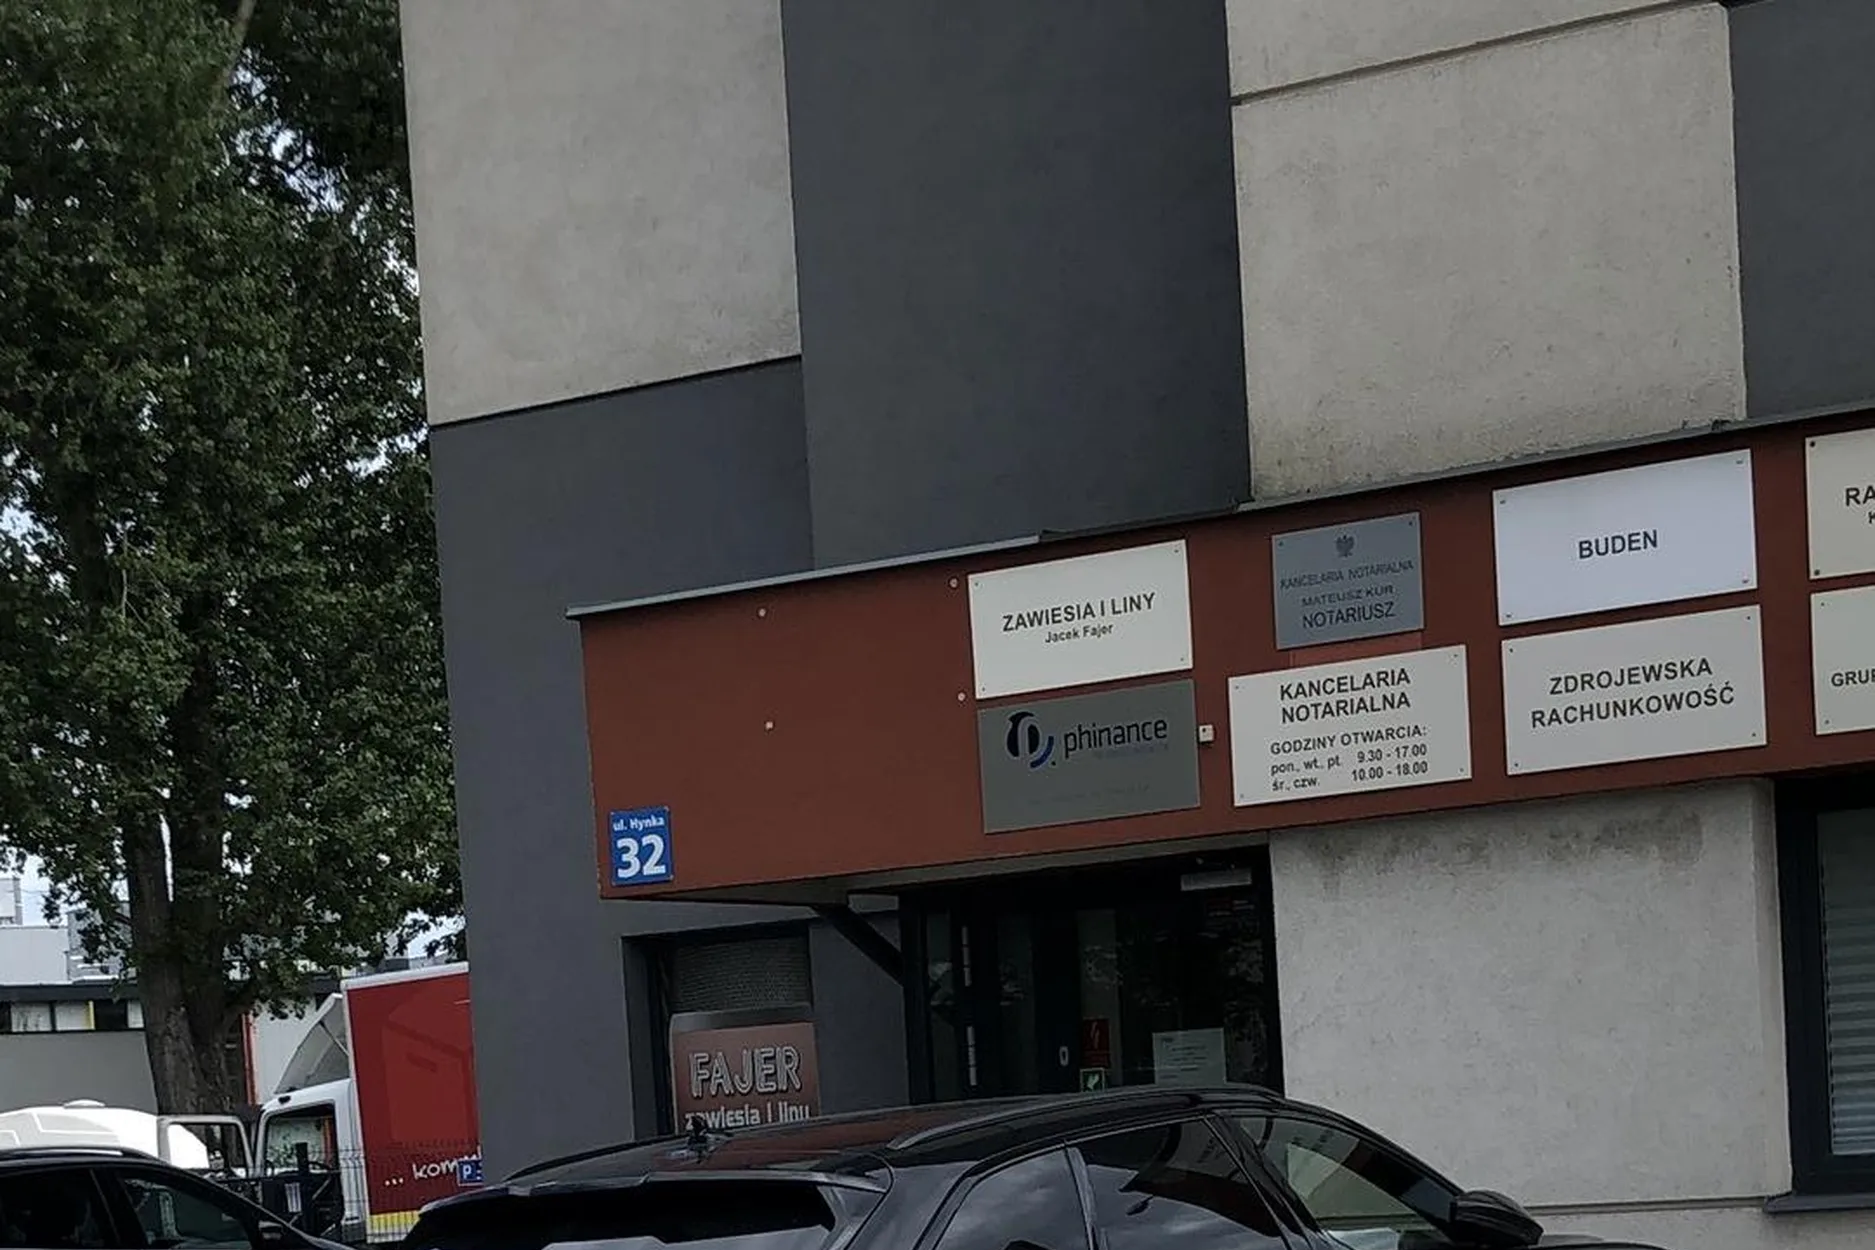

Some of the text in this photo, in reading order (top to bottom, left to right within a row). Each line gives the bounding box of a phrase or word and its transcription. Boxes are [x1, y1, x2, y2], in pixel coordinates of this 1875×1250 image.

[1578, 529, 1658, 559] BUDEN
[1280, 559, 1414, 590] KANCELARIA NOTARIALNA
[1002, 592, 1156, 632] ZAWIESIA I LINY
[1301, 588, 1363, 606] MATEUSZ
[1302, 601, 1397, 629] NOTARIUSZ
[1045, 623, 1113, 643] Jacek Fajer
[1280, 667, 1411, 701] KANCELARIA
[1550, 657, 1713, 695] ZDROJEWSKA
[1281, 691, 1411, 724] NOTARIALNA
[1531, 681, 1735, 729] RACHUNKOWOŚĆ
[1064, 718, 1168, 759] phinance
[1270, 723, 1428, 755] GODZINY OTWARCIA:
[1351, 765, 1384, 782] 10.00
[1396, 760, 1428, 776] 18.00
[1356, 748, 1383, 763] 9.30
[613, 818, 628, 831] ul.
[616, 833, 667, 878] 32
[688, 1045, 803, 1098] FAJER
